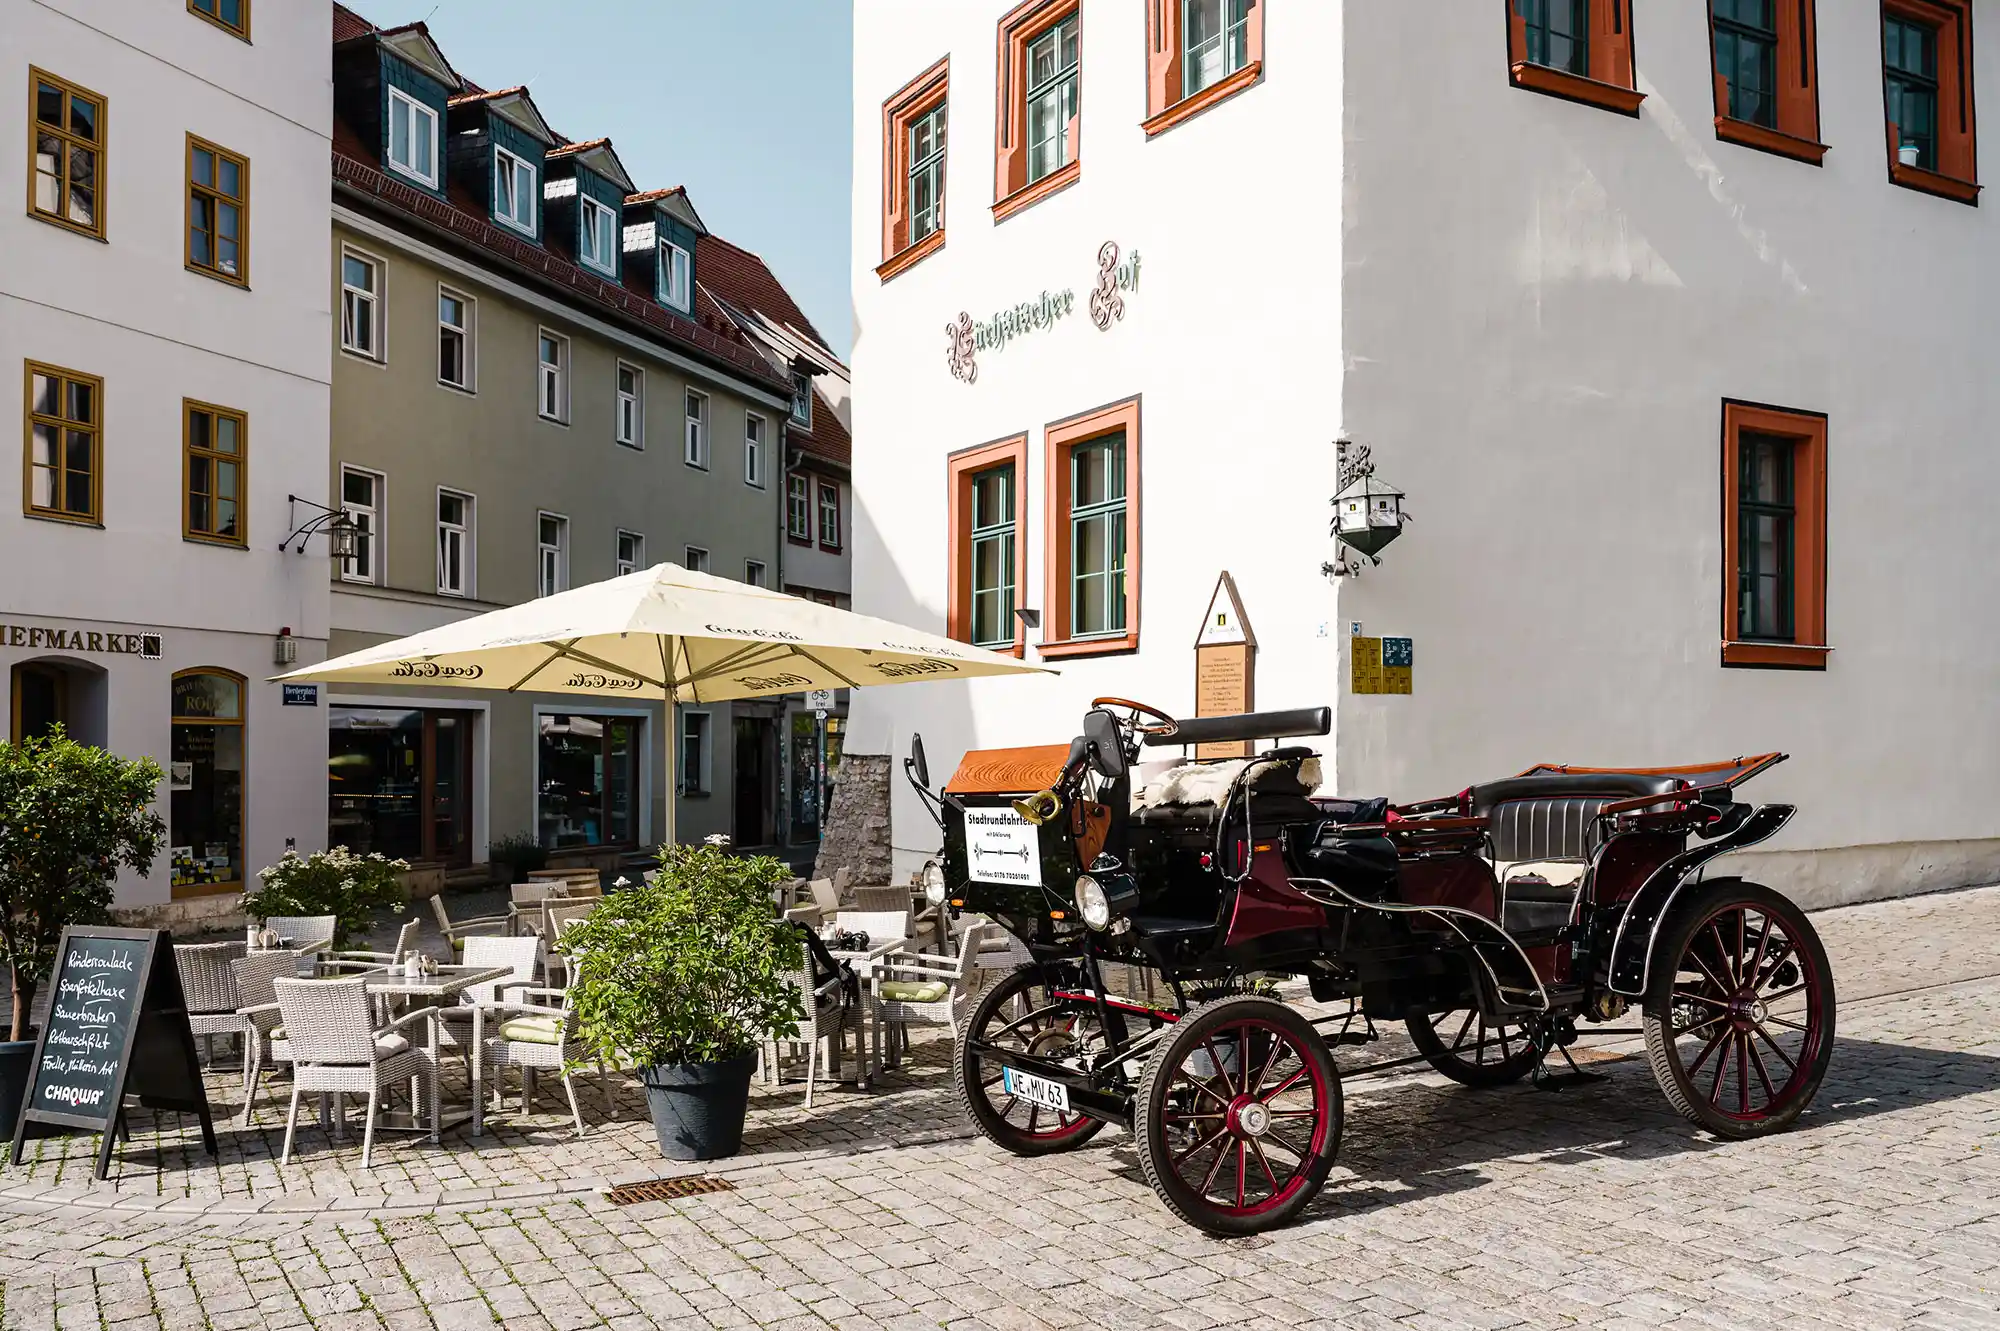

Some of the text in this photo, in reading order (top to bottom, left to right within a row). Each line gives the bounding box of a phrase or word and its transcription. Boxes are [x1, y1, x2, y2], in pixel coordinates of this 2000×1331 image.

[704, 623, 803, 641] Coca-Cola
[68, 949, 133, 971] Rinderroulade
[60, 978, 126, 1001] Spanferkelhaxe
[55, 1004, 116, 1023] Sauerbraten
[48, 1028, 111, 1055] Rotbarschfilet
[45, 1084, 104, 1107] CHAQWA
[1048, 1084, 1063, 1106] 63
